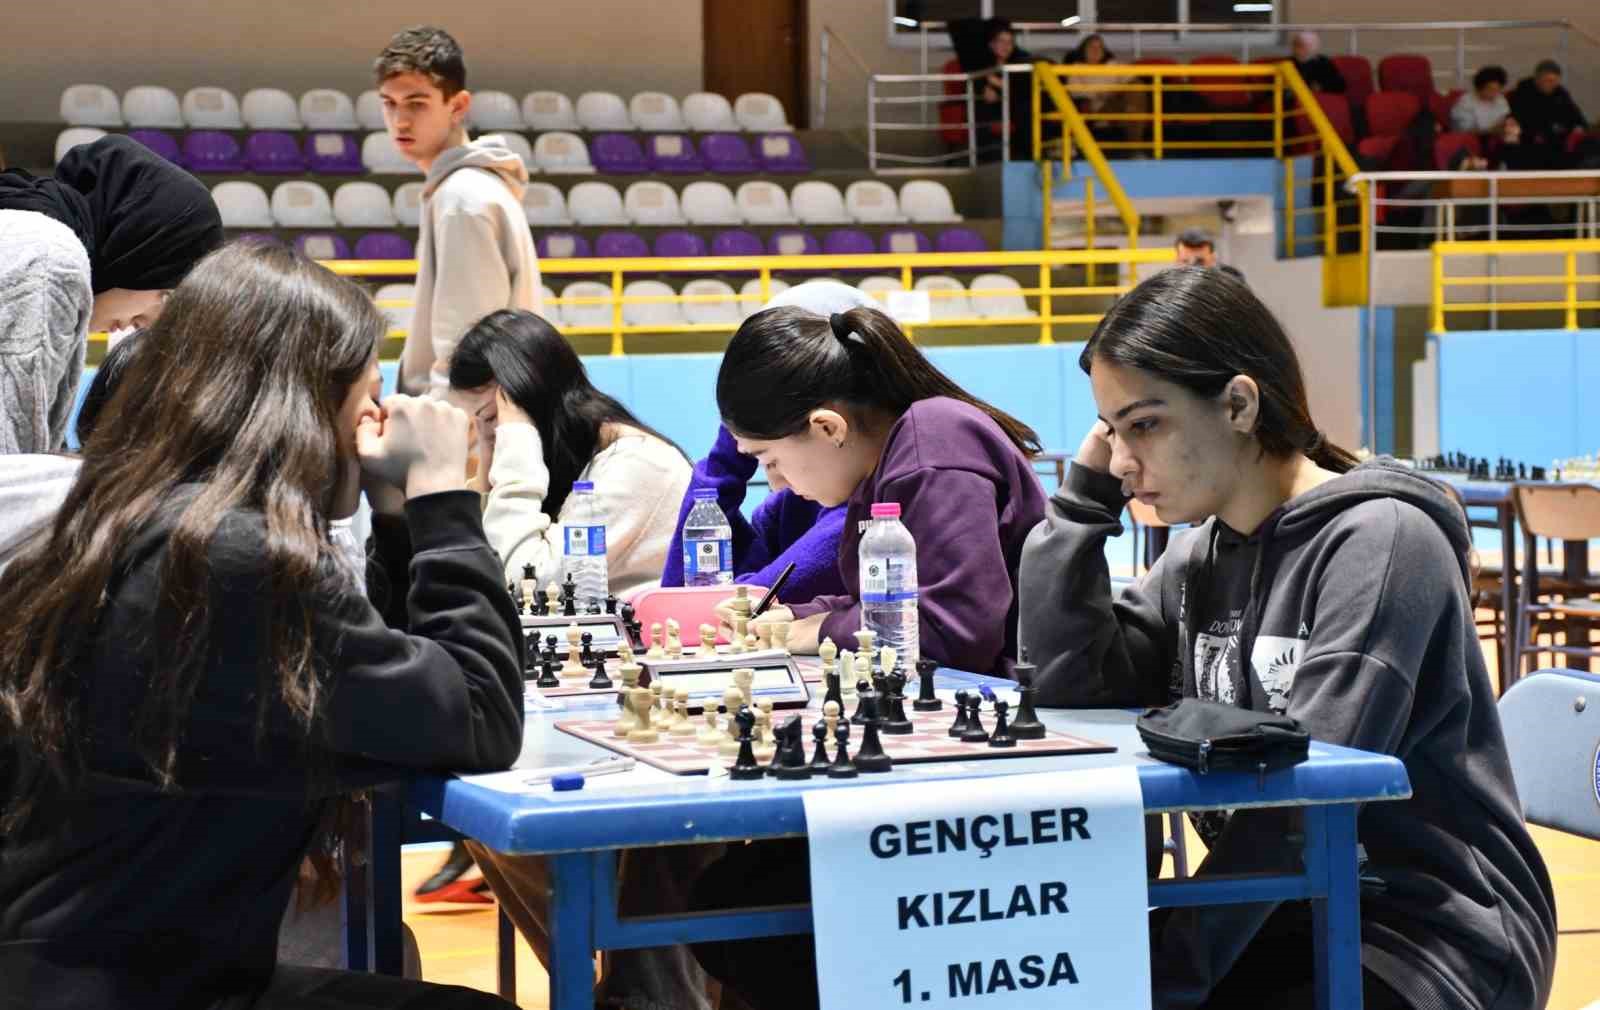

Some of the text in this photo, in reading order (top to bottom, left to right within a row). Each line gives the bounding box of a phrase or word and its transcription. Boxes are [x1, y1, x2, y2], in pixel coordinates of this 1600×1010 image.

[869, 806, 1092, 859] GENÇLER
[897, 881, 1070, 931] KIZLAR
[893, 952, 1079, 1004] 1. MASA
